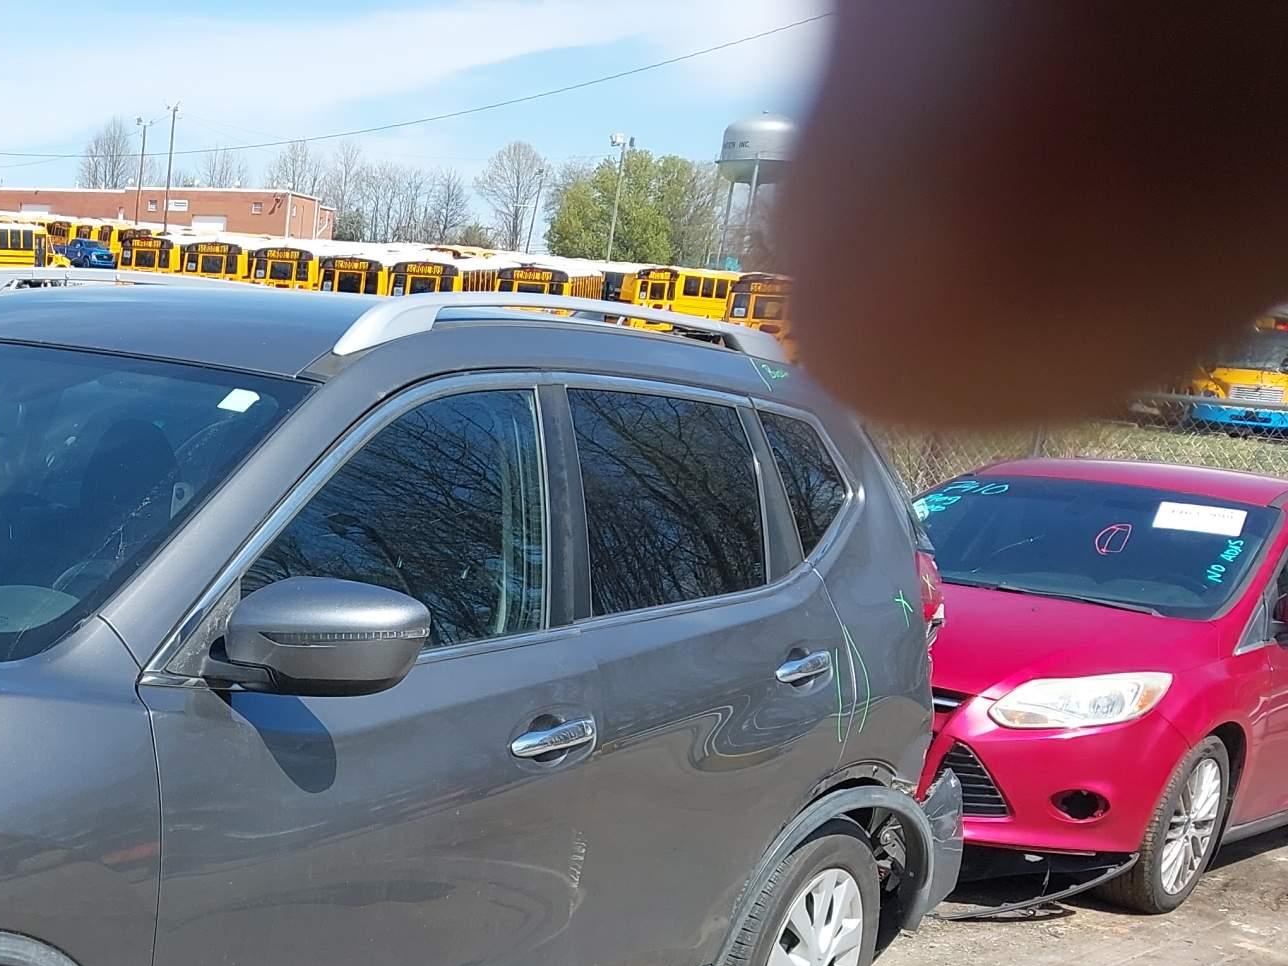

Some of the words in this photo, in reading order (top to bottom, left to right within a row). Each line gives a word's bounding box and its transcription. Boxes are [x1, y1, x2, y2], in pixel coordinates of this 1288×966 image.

[407, 264, 433, 275] SCHOOL
[432, 265, 443, 276] BUS
[513, 270, 541, 281] SCHOOL
[541, 271, 553, 281] BUS
[1206, 564, 1226, 583] NO
